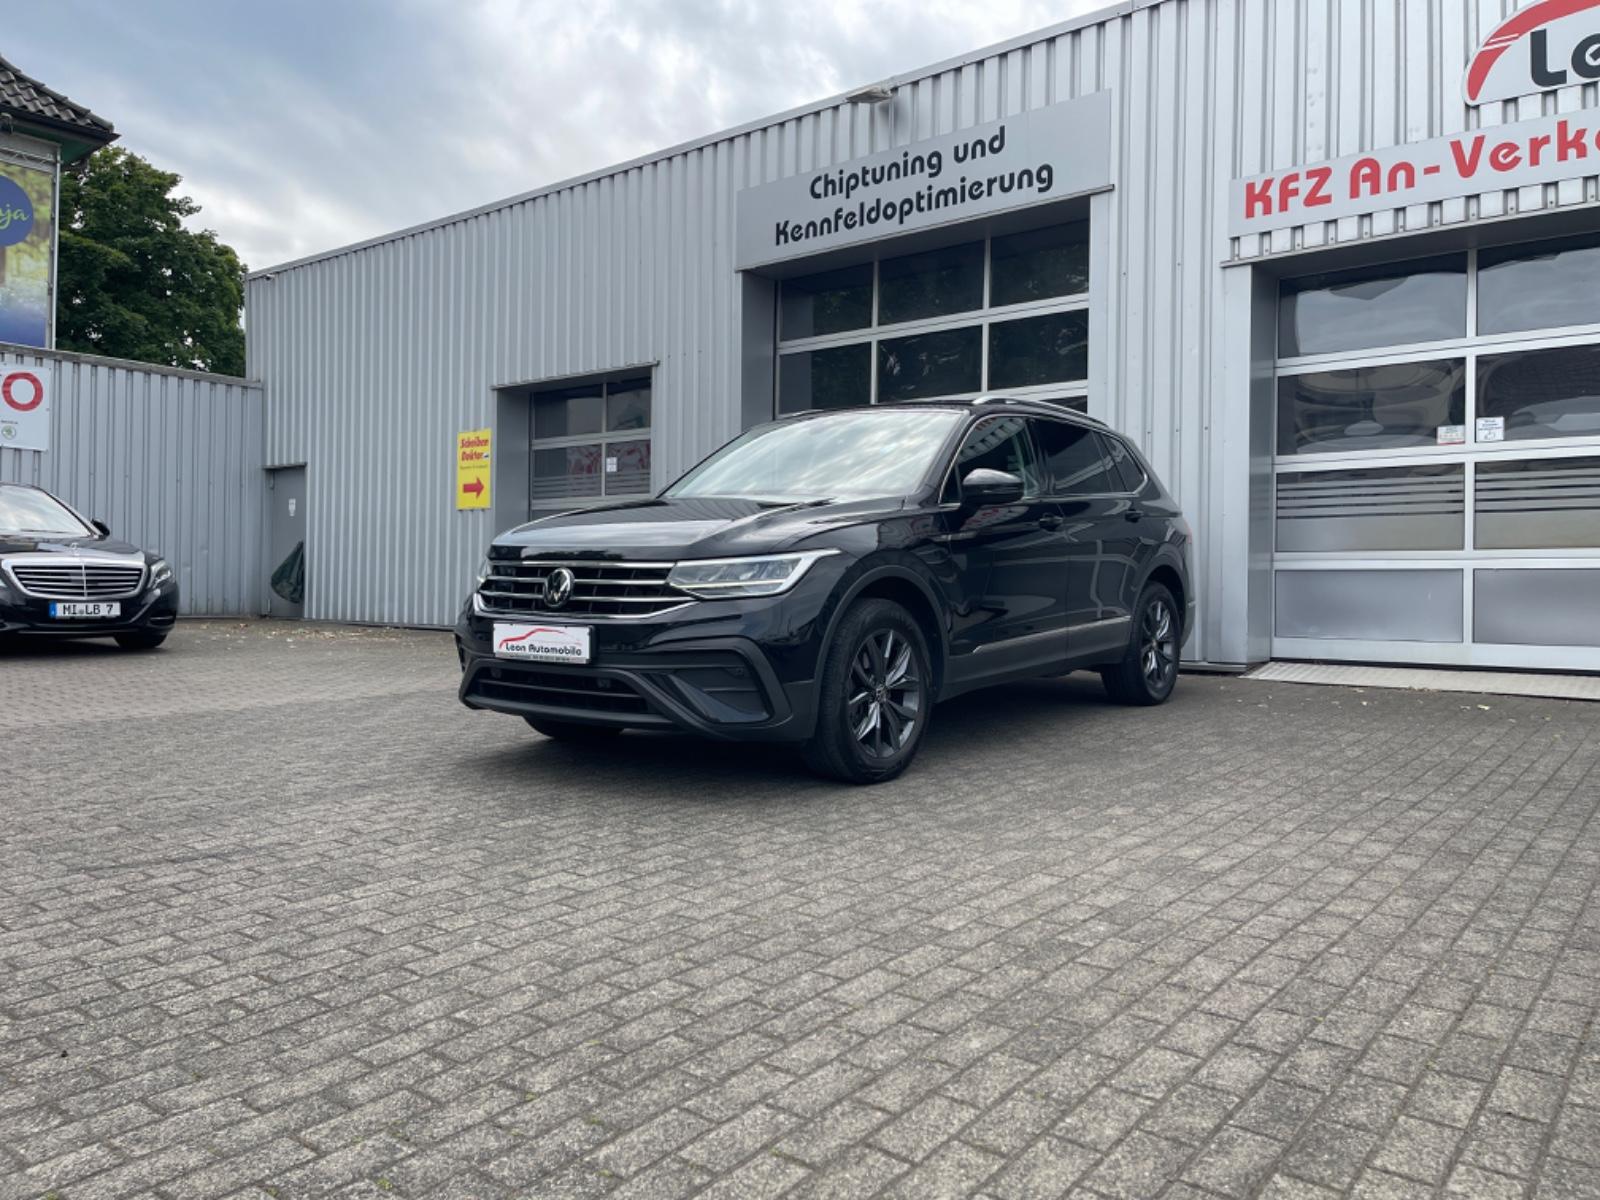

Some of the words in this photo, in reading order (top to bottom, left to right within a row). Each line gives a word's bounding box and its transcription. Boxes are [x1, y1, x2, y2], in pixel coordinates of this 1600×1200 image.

[809, 150, 942, 200] Chiptuning
[953, 125, 1006, 164] und
[1350, 120, 1600, 200] An-Verk
[0, 203, 29, 230] ja
[775, 163, 1053, 246] Kennfeldoptimierung
[106, 604, 114, 615] 7
[506, 642, 526, 652] Leon
[528, 643, 582, 656] Automobile
